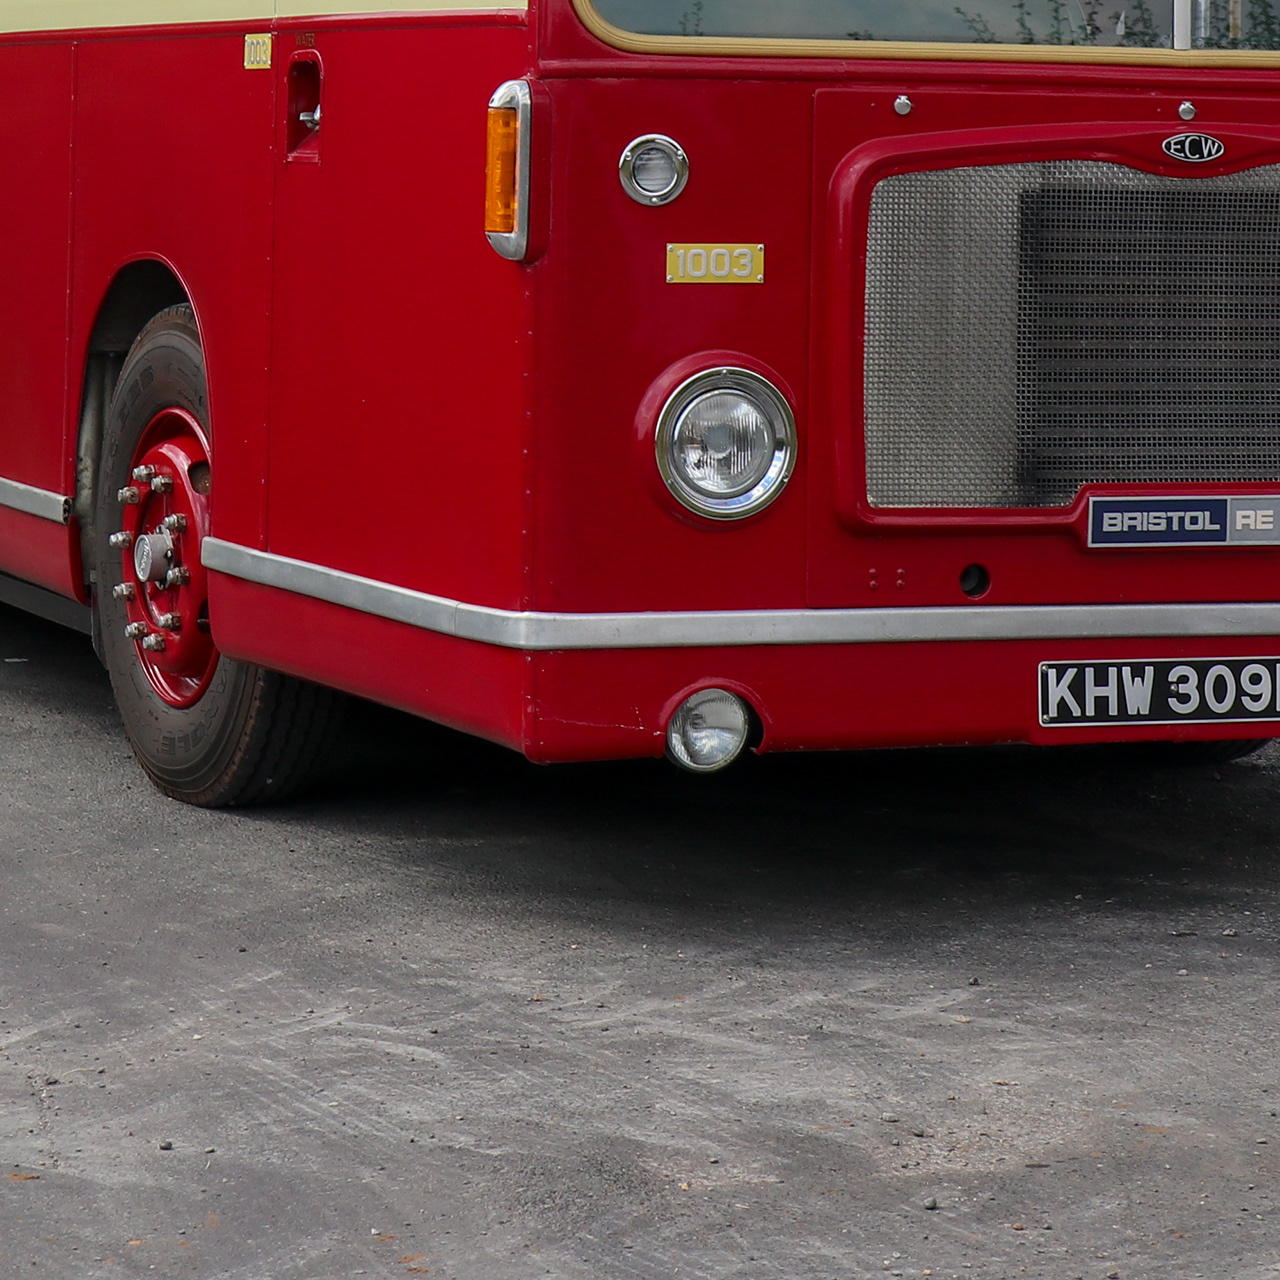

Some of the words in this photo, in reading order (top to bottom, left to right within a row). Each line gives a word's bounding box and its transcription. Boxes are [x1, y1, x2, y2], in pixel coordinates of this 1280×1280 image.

[247, 39, 268, 64] 1003
[1170, 136, 1218, 159] ECW
[676, 248, 753, 277] 1003
[1102, 510, 1221, 532] BRISTOL
[1235, 509, 1275, 531] RE
[1047, 666, 1154, 718] KHW
